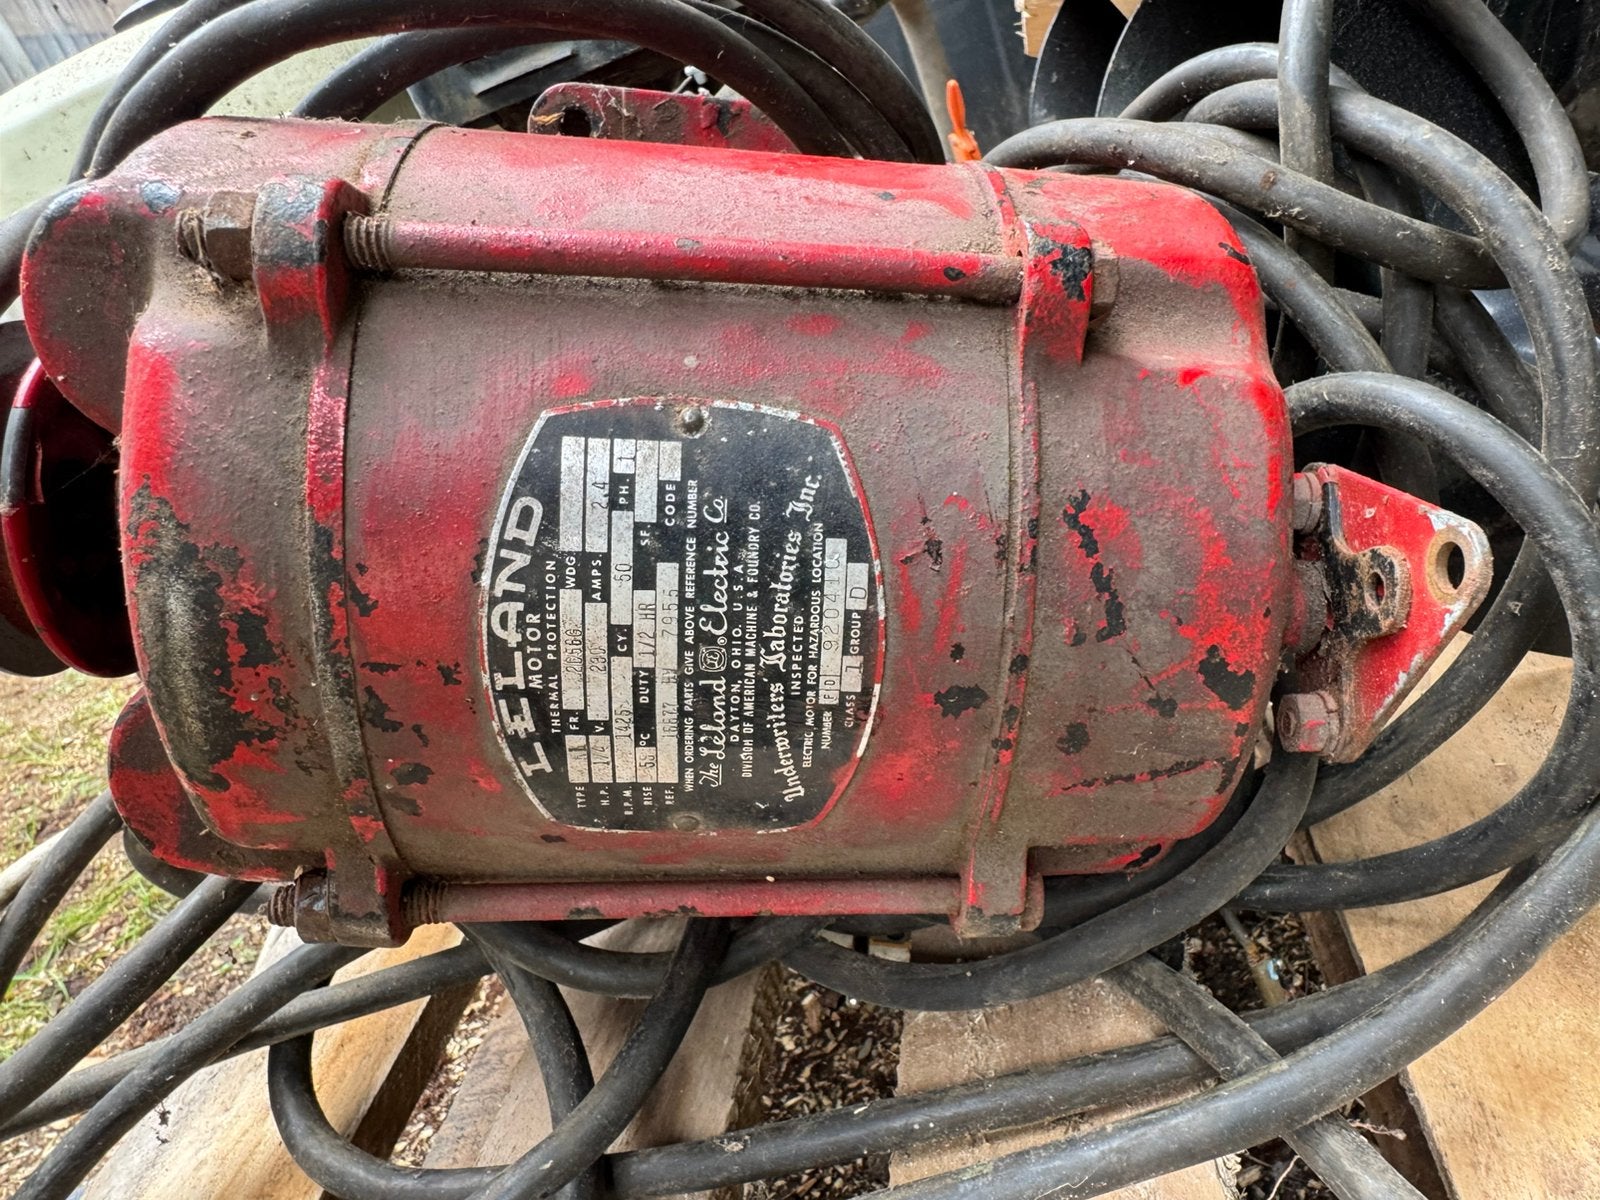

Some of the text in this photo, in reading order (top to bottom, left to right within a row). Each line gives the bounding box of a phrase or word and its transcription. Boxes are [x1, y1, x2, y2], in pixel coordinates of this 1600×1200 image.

[591, 481, 609, 509] 2.4
[619, 478, 630, 504] PH.
[665, 484, 676, 526] CODE
[591, 554, 602, 600] AMPS.
[613, 564, 632, 582] 50
[699, 532, 729, 636] Electric
[759, 530, 802, 672] Laboratories
[783, 474, 822, 521] Inc.
[638, 604, 655, 620] HR
[850, 587, 867, 599] D
[662, 590, 679, 636] 7955
[491, 496, 553, 776] LELAND
[526, 614, 543, 689] MOTOR
[546, 561, 561, 733] THERMAL PROTECTION
[617, 628, 628, 652] CY.
[639, 631, 656, 656] 1/2
[684, 480, 698, 792] WHEN ORDERING PARTS GIVE ABOVE REFERENCE NUMBER
[732, 625, 742, 668] OHIO.
[741, 501, 760, 777] DIVISION OF AMERICAN MACHINE & FOUNDRY CO.
[803, 523, 824, 767] ELECTRIC MOTOR FOR HAZARDOUS LOCATION
[850, 612, 861, 654] GROUP
[639, 670, 650, 703] DUTY
[569, 712, 579, 730] FR.
[699, 676, 726, 760] Leland
[731, 680, 742, 742] DAYTON,
[844, 694, 855, 727] CLASS
[822, 711, 832, 749] NUMBER
[699, 762, 720, 787] The
[575, 786, 586, 808] TYPE
[600, 786, 610, 806] H.P.
[644, 786, 652, 805] RISE
[666, 786, 675, 804] REF.
